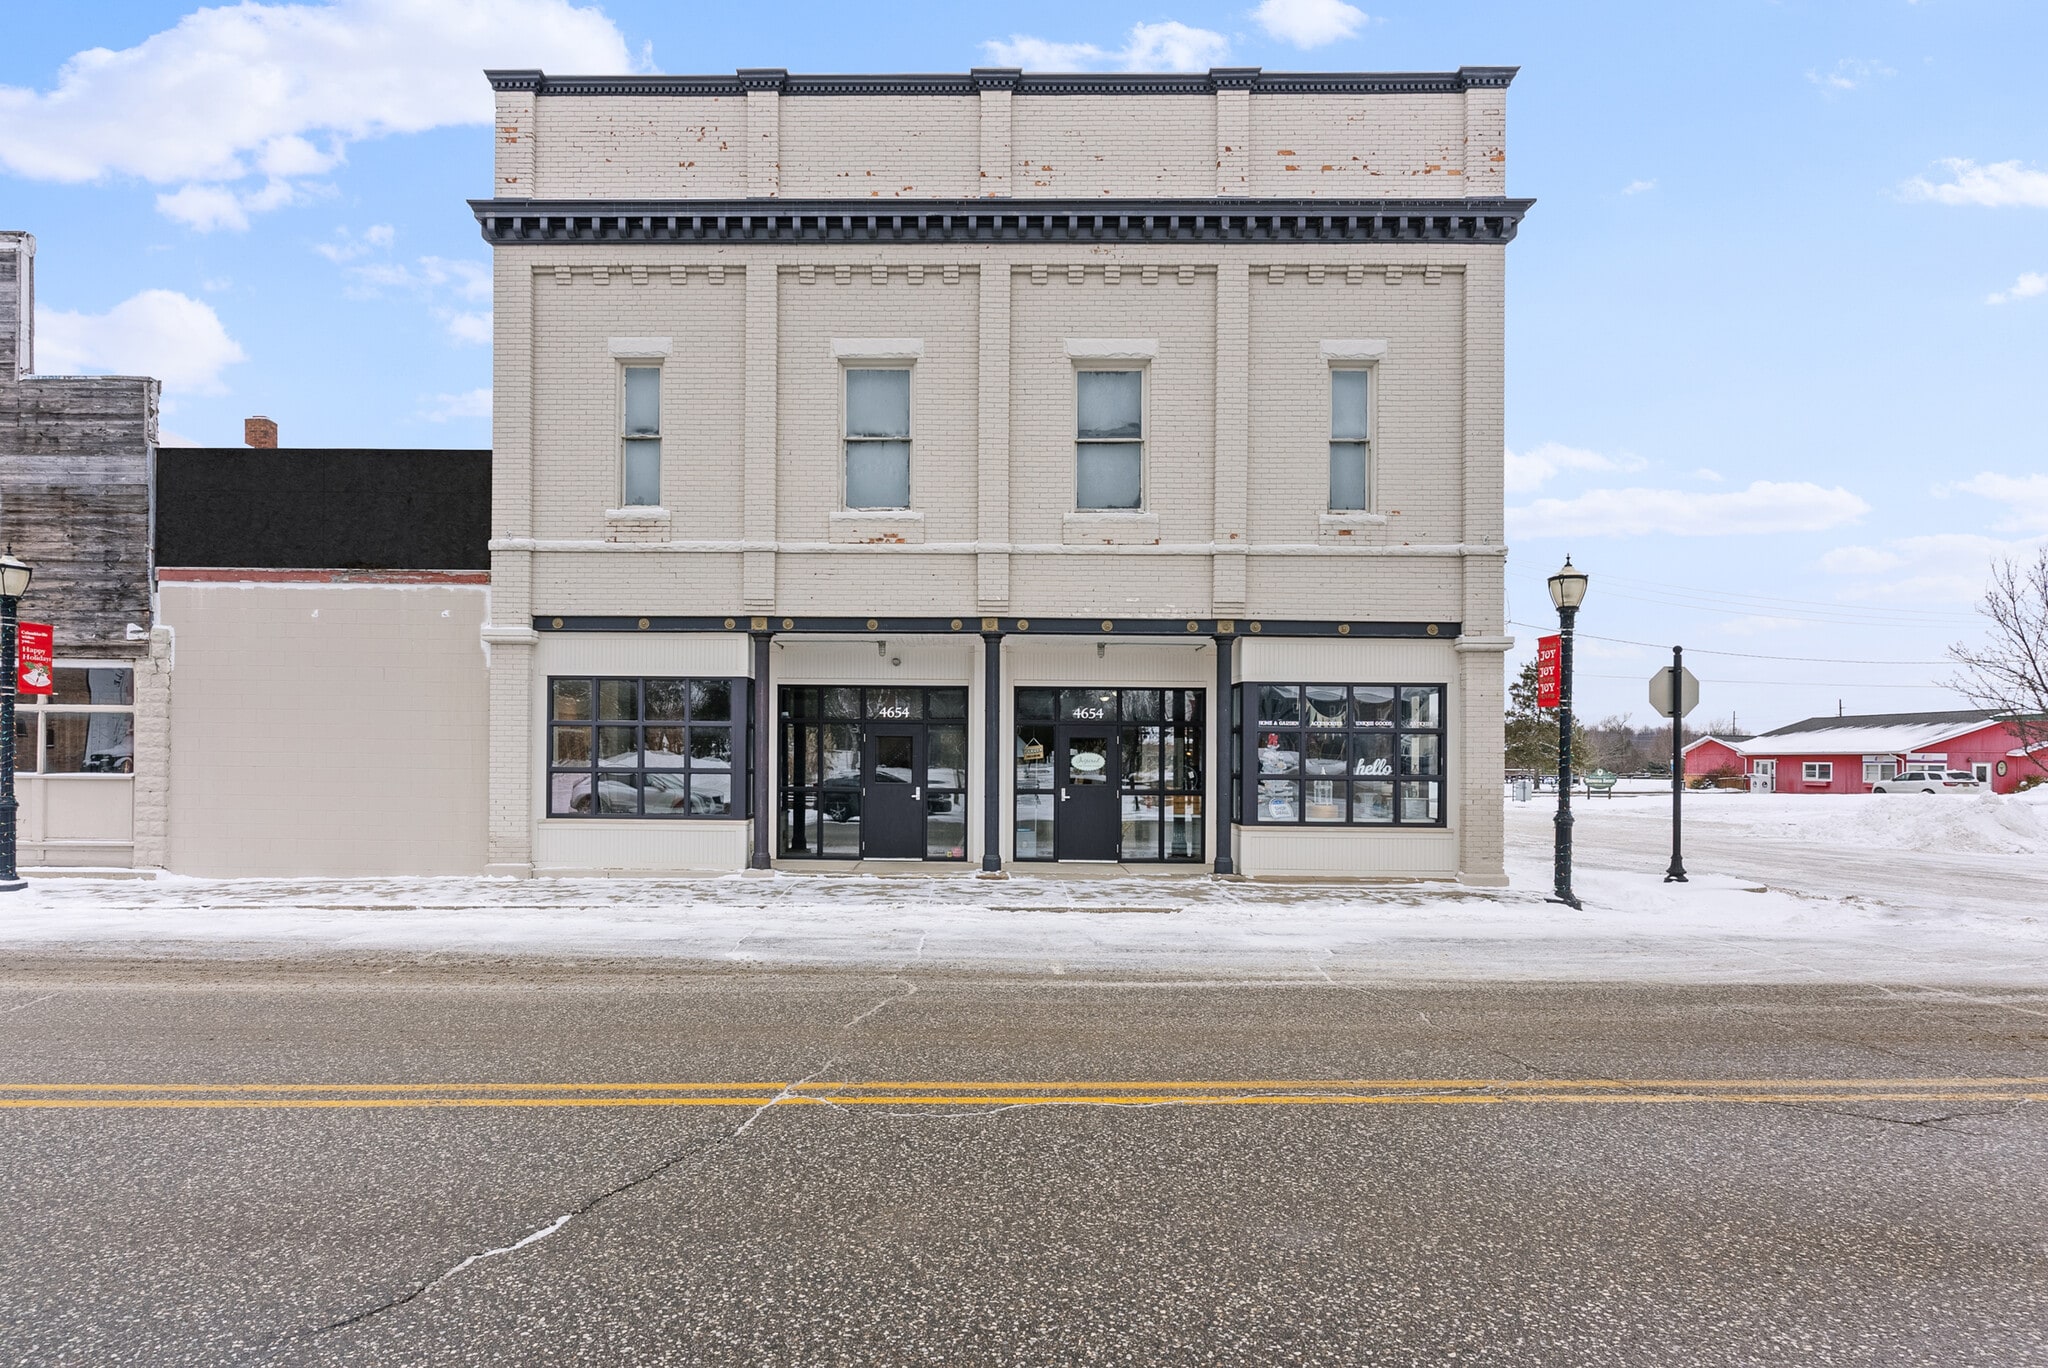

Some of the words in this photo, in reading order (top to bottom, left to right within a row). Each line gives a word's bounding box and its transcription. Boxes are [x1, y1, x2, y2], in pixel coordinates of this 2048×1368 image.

[22, 646, 46, 656] Happy
[1540, 649, 1556, 661] JOY
[1539, 666, 1555, 677] JOY
[1540, 683, 1555, 694] JOY
[879, 706, 910, 718] 4654
[1072, 707, 1104, 719] 4654
[1354, 757, 1392, 775] hello
